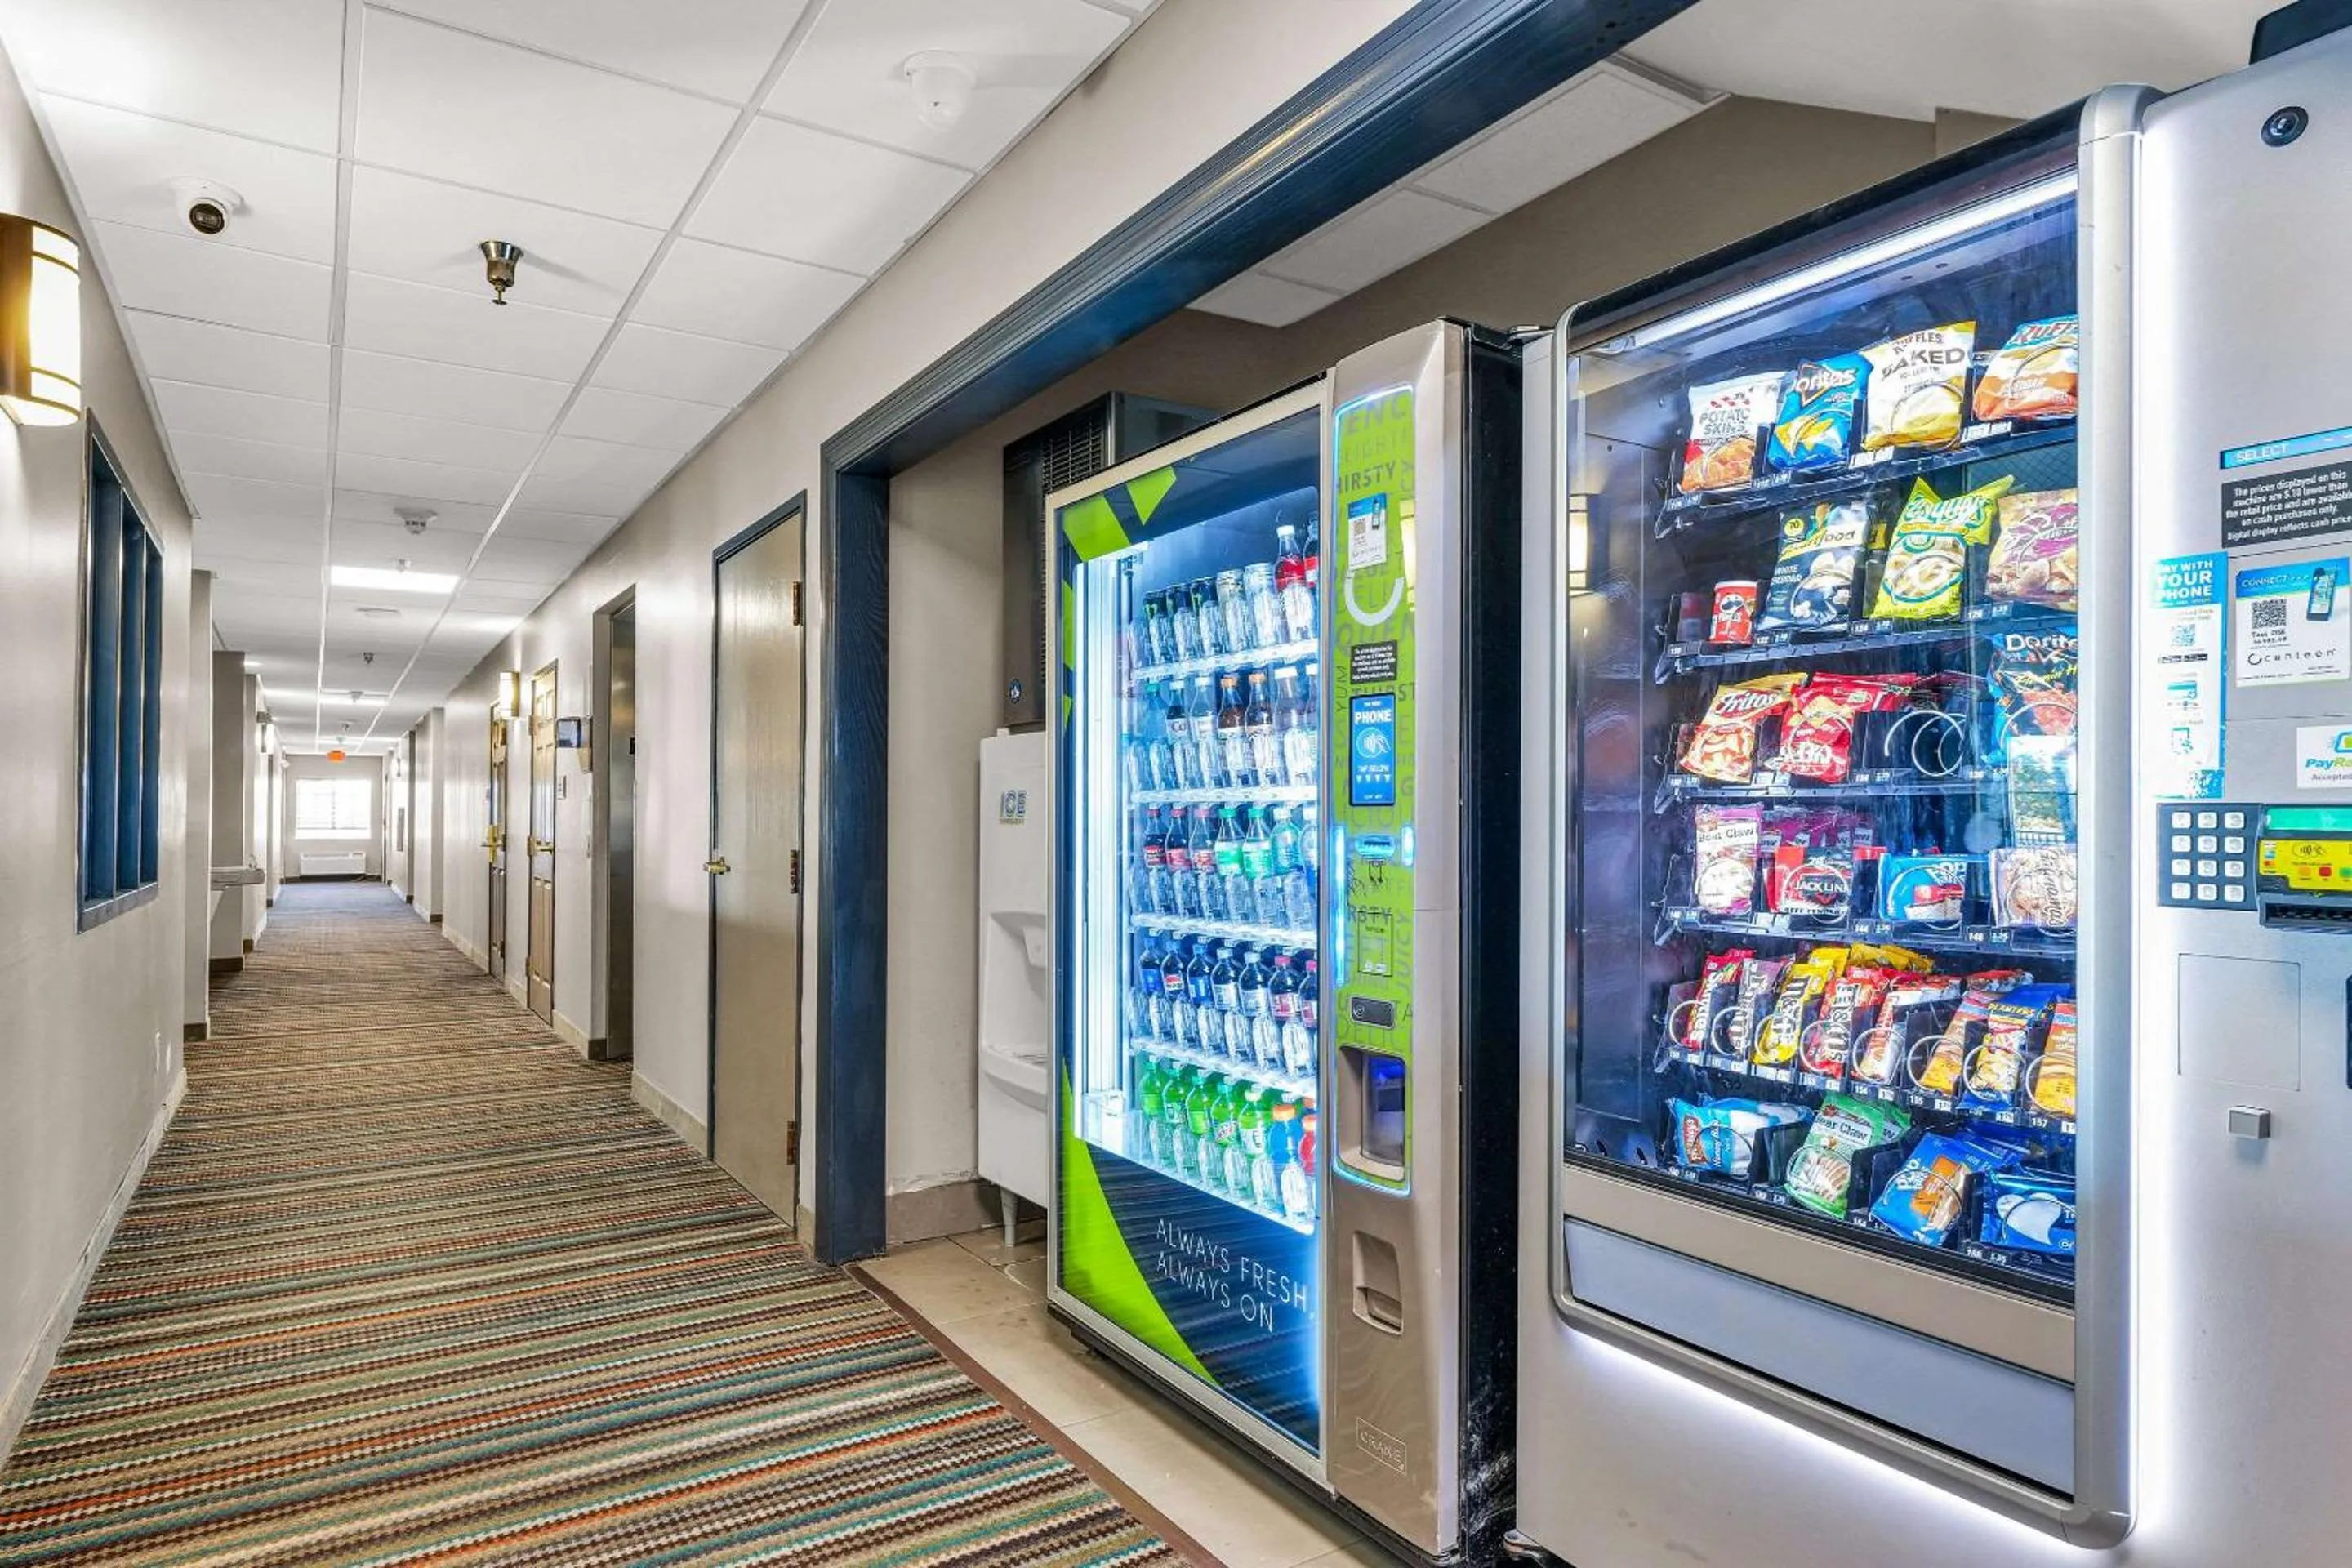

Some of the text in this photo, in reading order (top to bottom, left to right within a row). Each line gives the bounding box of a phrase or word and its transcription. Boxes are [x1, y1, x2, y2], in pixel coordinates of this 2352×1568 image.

[1882, 347, 1965, 381] BAKED
[2237, 443, 2287, 461] SELECT
[2233, 496, 2267, 506] machine
[2269, 493, 2282, 501] are
[2303, 485, 2327, 496] lower
[2328, 482, 2348, 492] than
[2234, 470, 2346, 497] The prices displayed on this
[2240, 506, 2260, 516] retail
[2262, 503, 2283, 514] price
[2284, 500, 2301, 509] and
[2302, 498, 2316, 506] are
[2253, 514, 2273, 524] cash
[2274, 507, 2317, 522] purchases
[2227, 531, 2252, 541] Digital
[2252, 526, 2278, 537] display
[2279, 522, 2309, 532] reflects
[2310, 518, 2329, 528] cash
[2181, 561, 2212, 571] WITH
[2242, 575, 2287, 587] CONNECT
[1715, 691, 1778, 714] Fritos
[1355, 709, 1392, 725] PHONE
[1000, 790, 1027, 817] ICE
[1987, 1003, 2034, 1016] PLANTERS
[1839, 1122, 1869, 1141] Claw
[1156, 1218, 1230, 1273] ALWAYS
[1156, 1250, 1273, 1333] ALWAYS ON
[1361, 1432, 1403, 1463] CRANE
